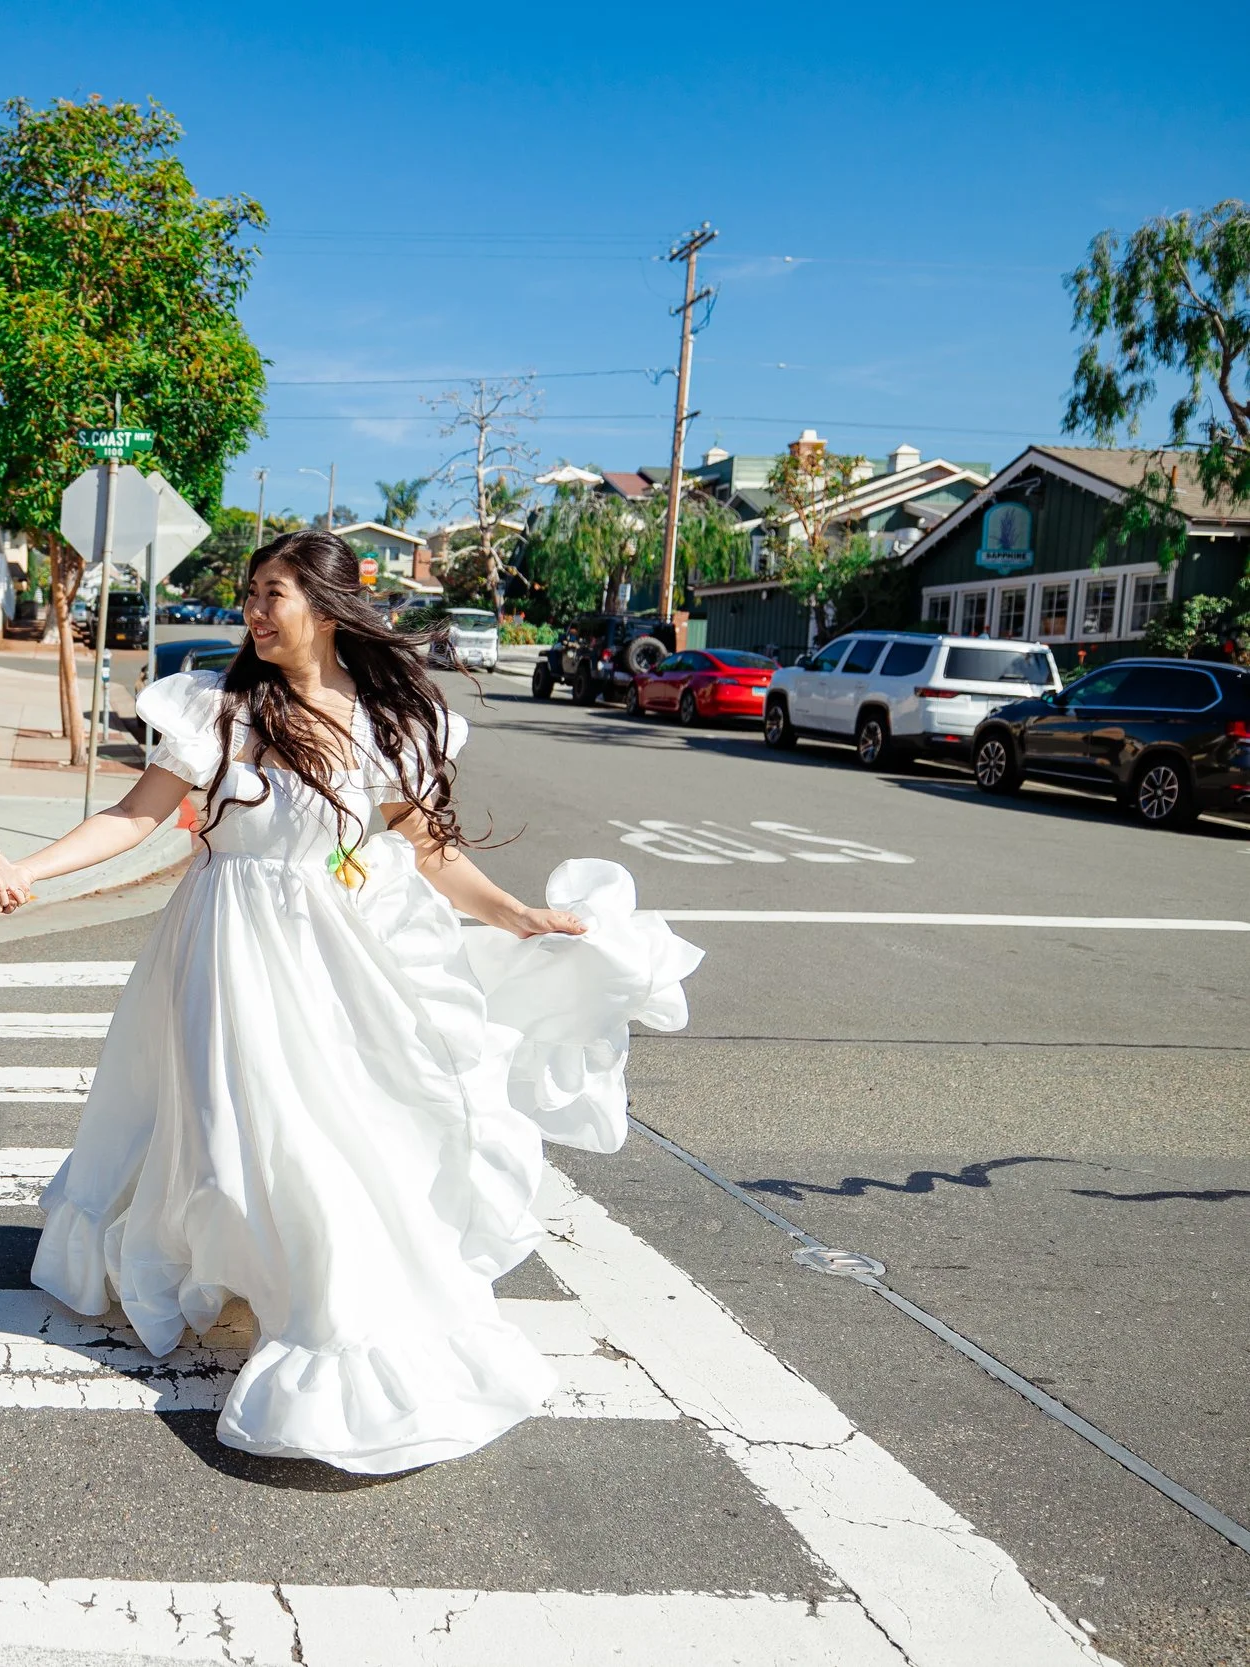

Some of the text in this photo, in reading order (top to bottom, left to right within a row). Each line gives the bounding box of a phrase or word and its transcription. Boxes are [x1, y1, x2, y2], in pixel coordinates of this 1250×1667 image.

[78, 431, 89, 446] S.
[91, 431, 132, 447] COAST
[104, 448, 124, 456] 1100
